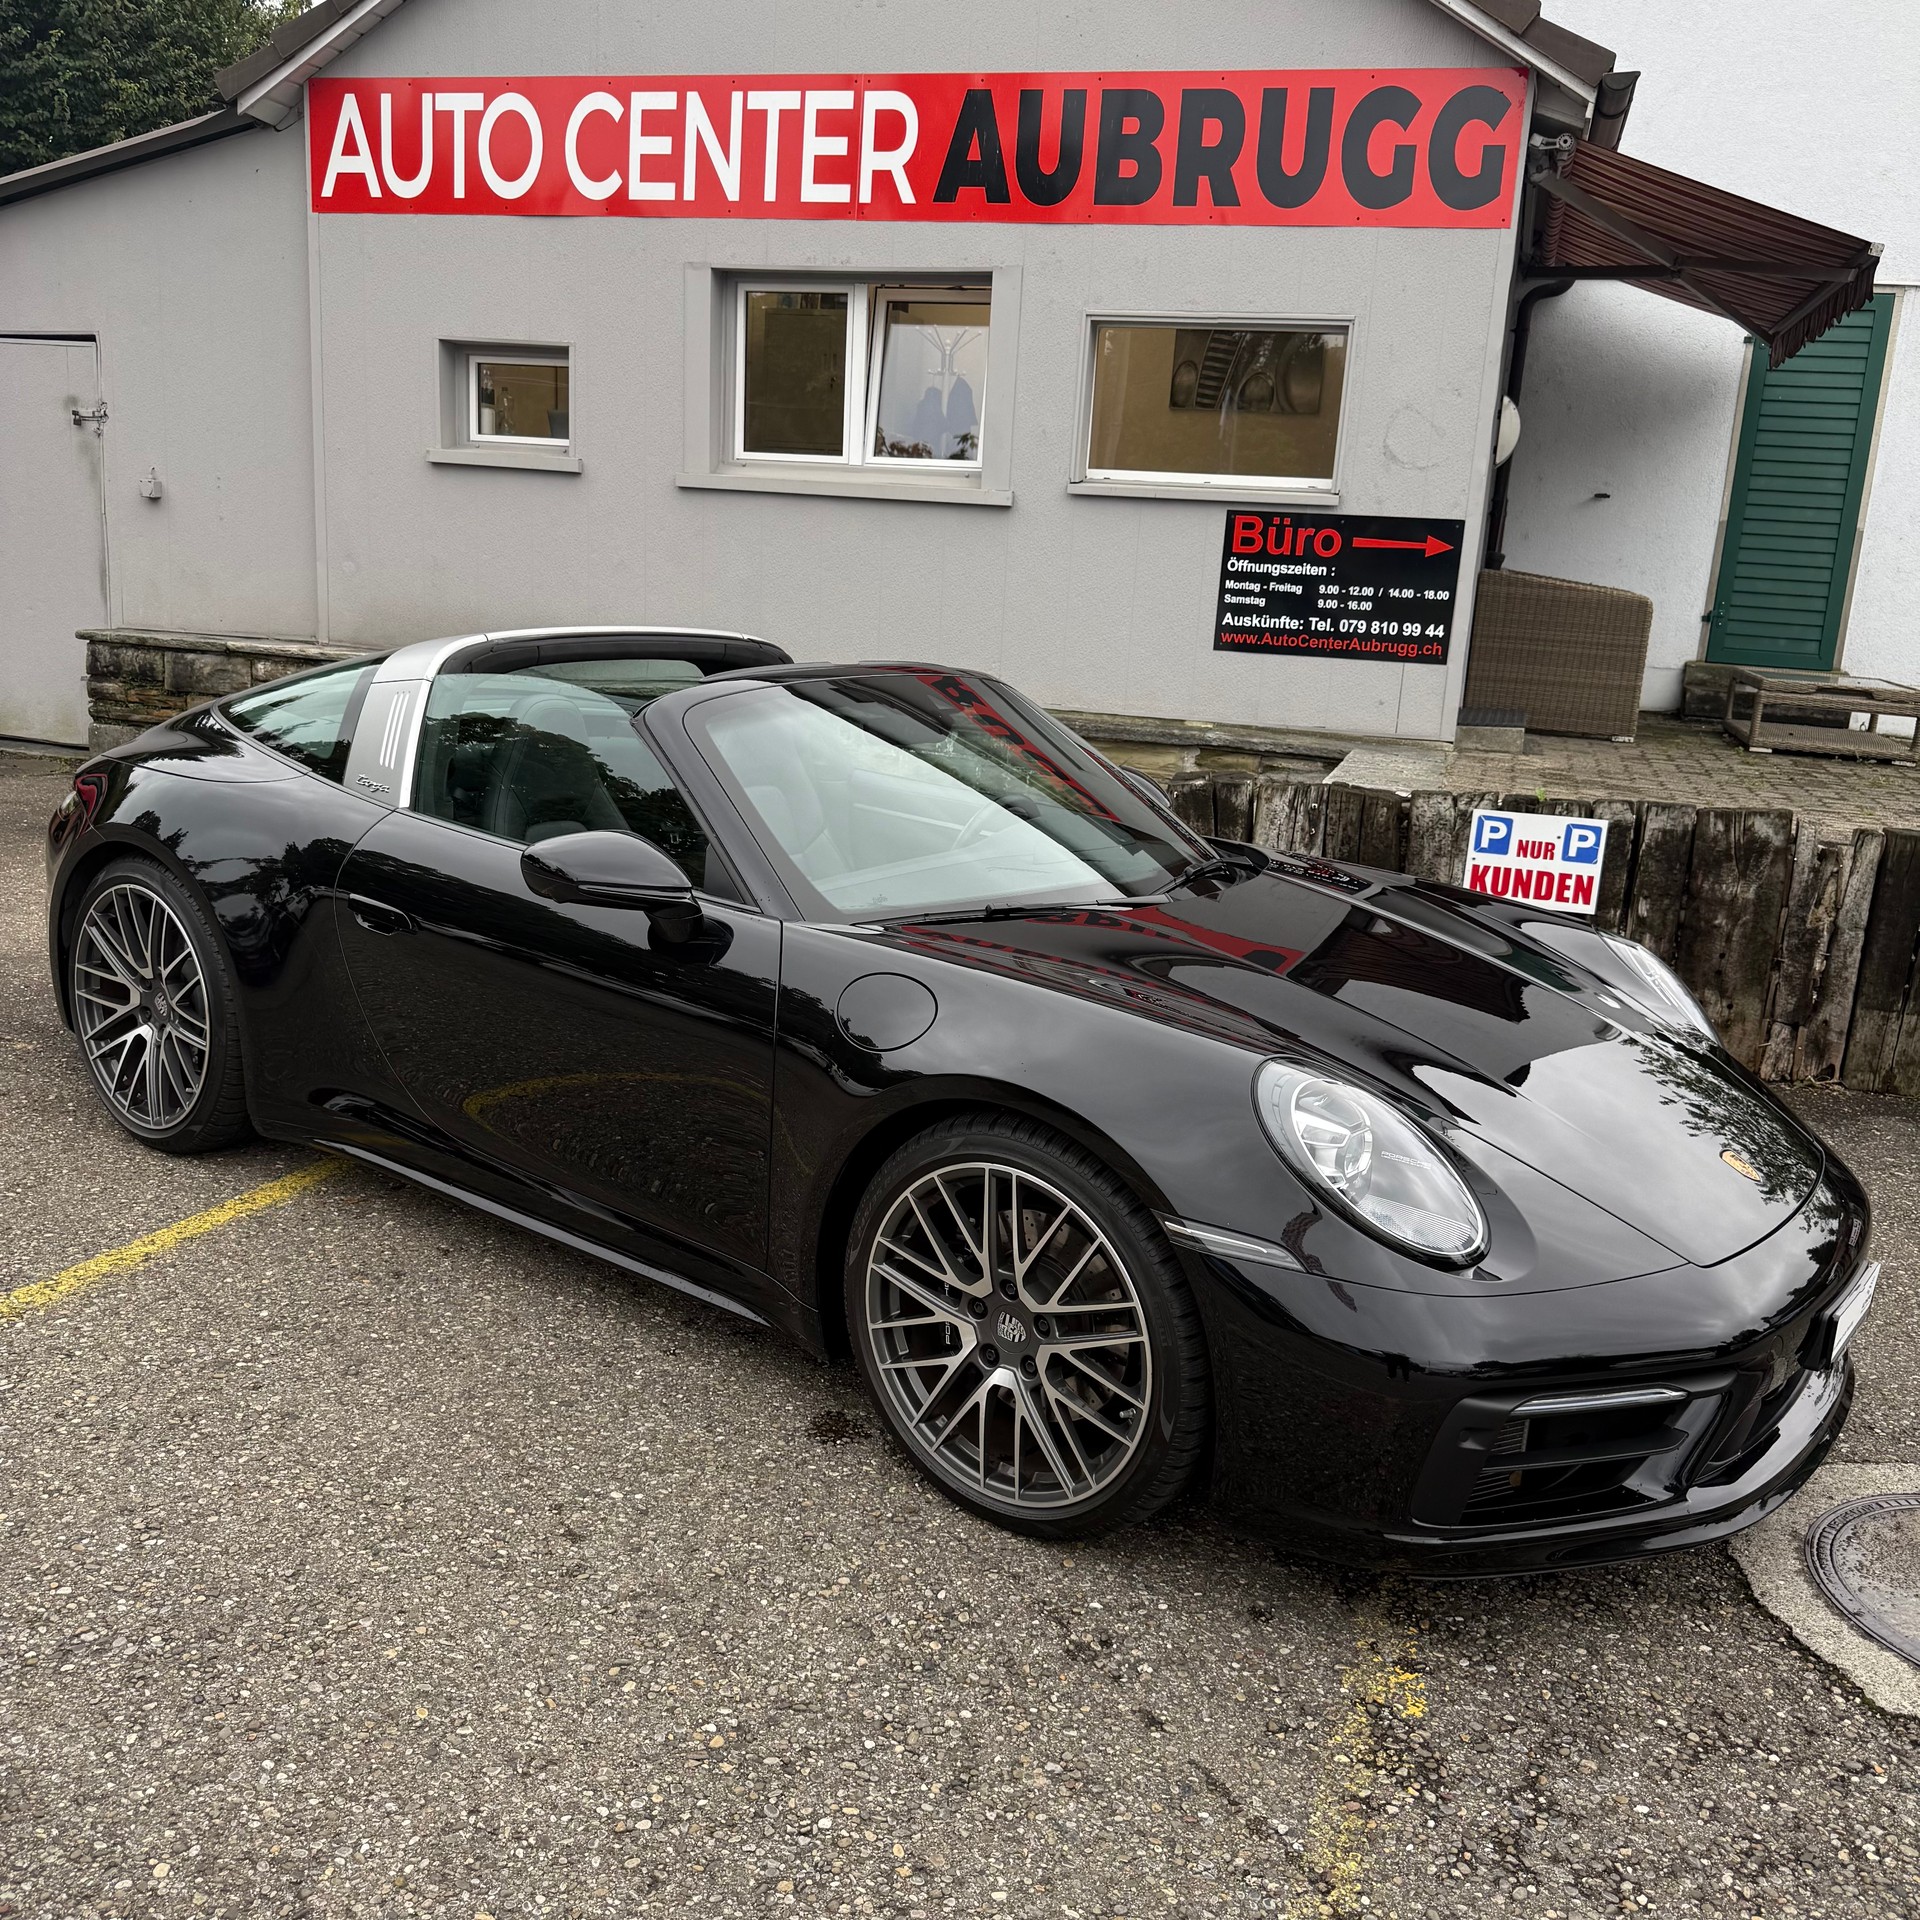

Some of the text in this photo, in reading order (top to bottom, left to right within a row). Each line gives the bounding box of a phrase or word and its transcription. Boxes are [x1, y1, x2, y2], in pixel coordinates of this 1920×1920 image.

[320, 85, 1513, 211] AUTO CENTER AUBRUGG
[1231, 514, 1343, 558] Büro
[1226, 556, 1328, 577] Öffnungszeiten
[1223, 593, 1266, 608] Samstag
[1317, 598, 1339, 609] 9.00
[1347, 600, 1373, 611] 16.00
[1224, 579, 1261, 593] Montag
[1269, 581, 1303, 595] Freitag
[1318, 584, 1340, 595] 9.00
[1348, 585, 1375, 597] 12.00
[1388, 587, 1415, 599] 14.00
[1423, 589, 1450, 601] 18.00
[1221, 612, 1445, 639] Auskünfte: Tel. 079 810 99 44
[1220, 631, 1443, 658] www.AutoCenterAubrugg.ch
[1480, 819, 1597, 861] P NUR P
[1469, 863, 1595, 906] KUNDEN
